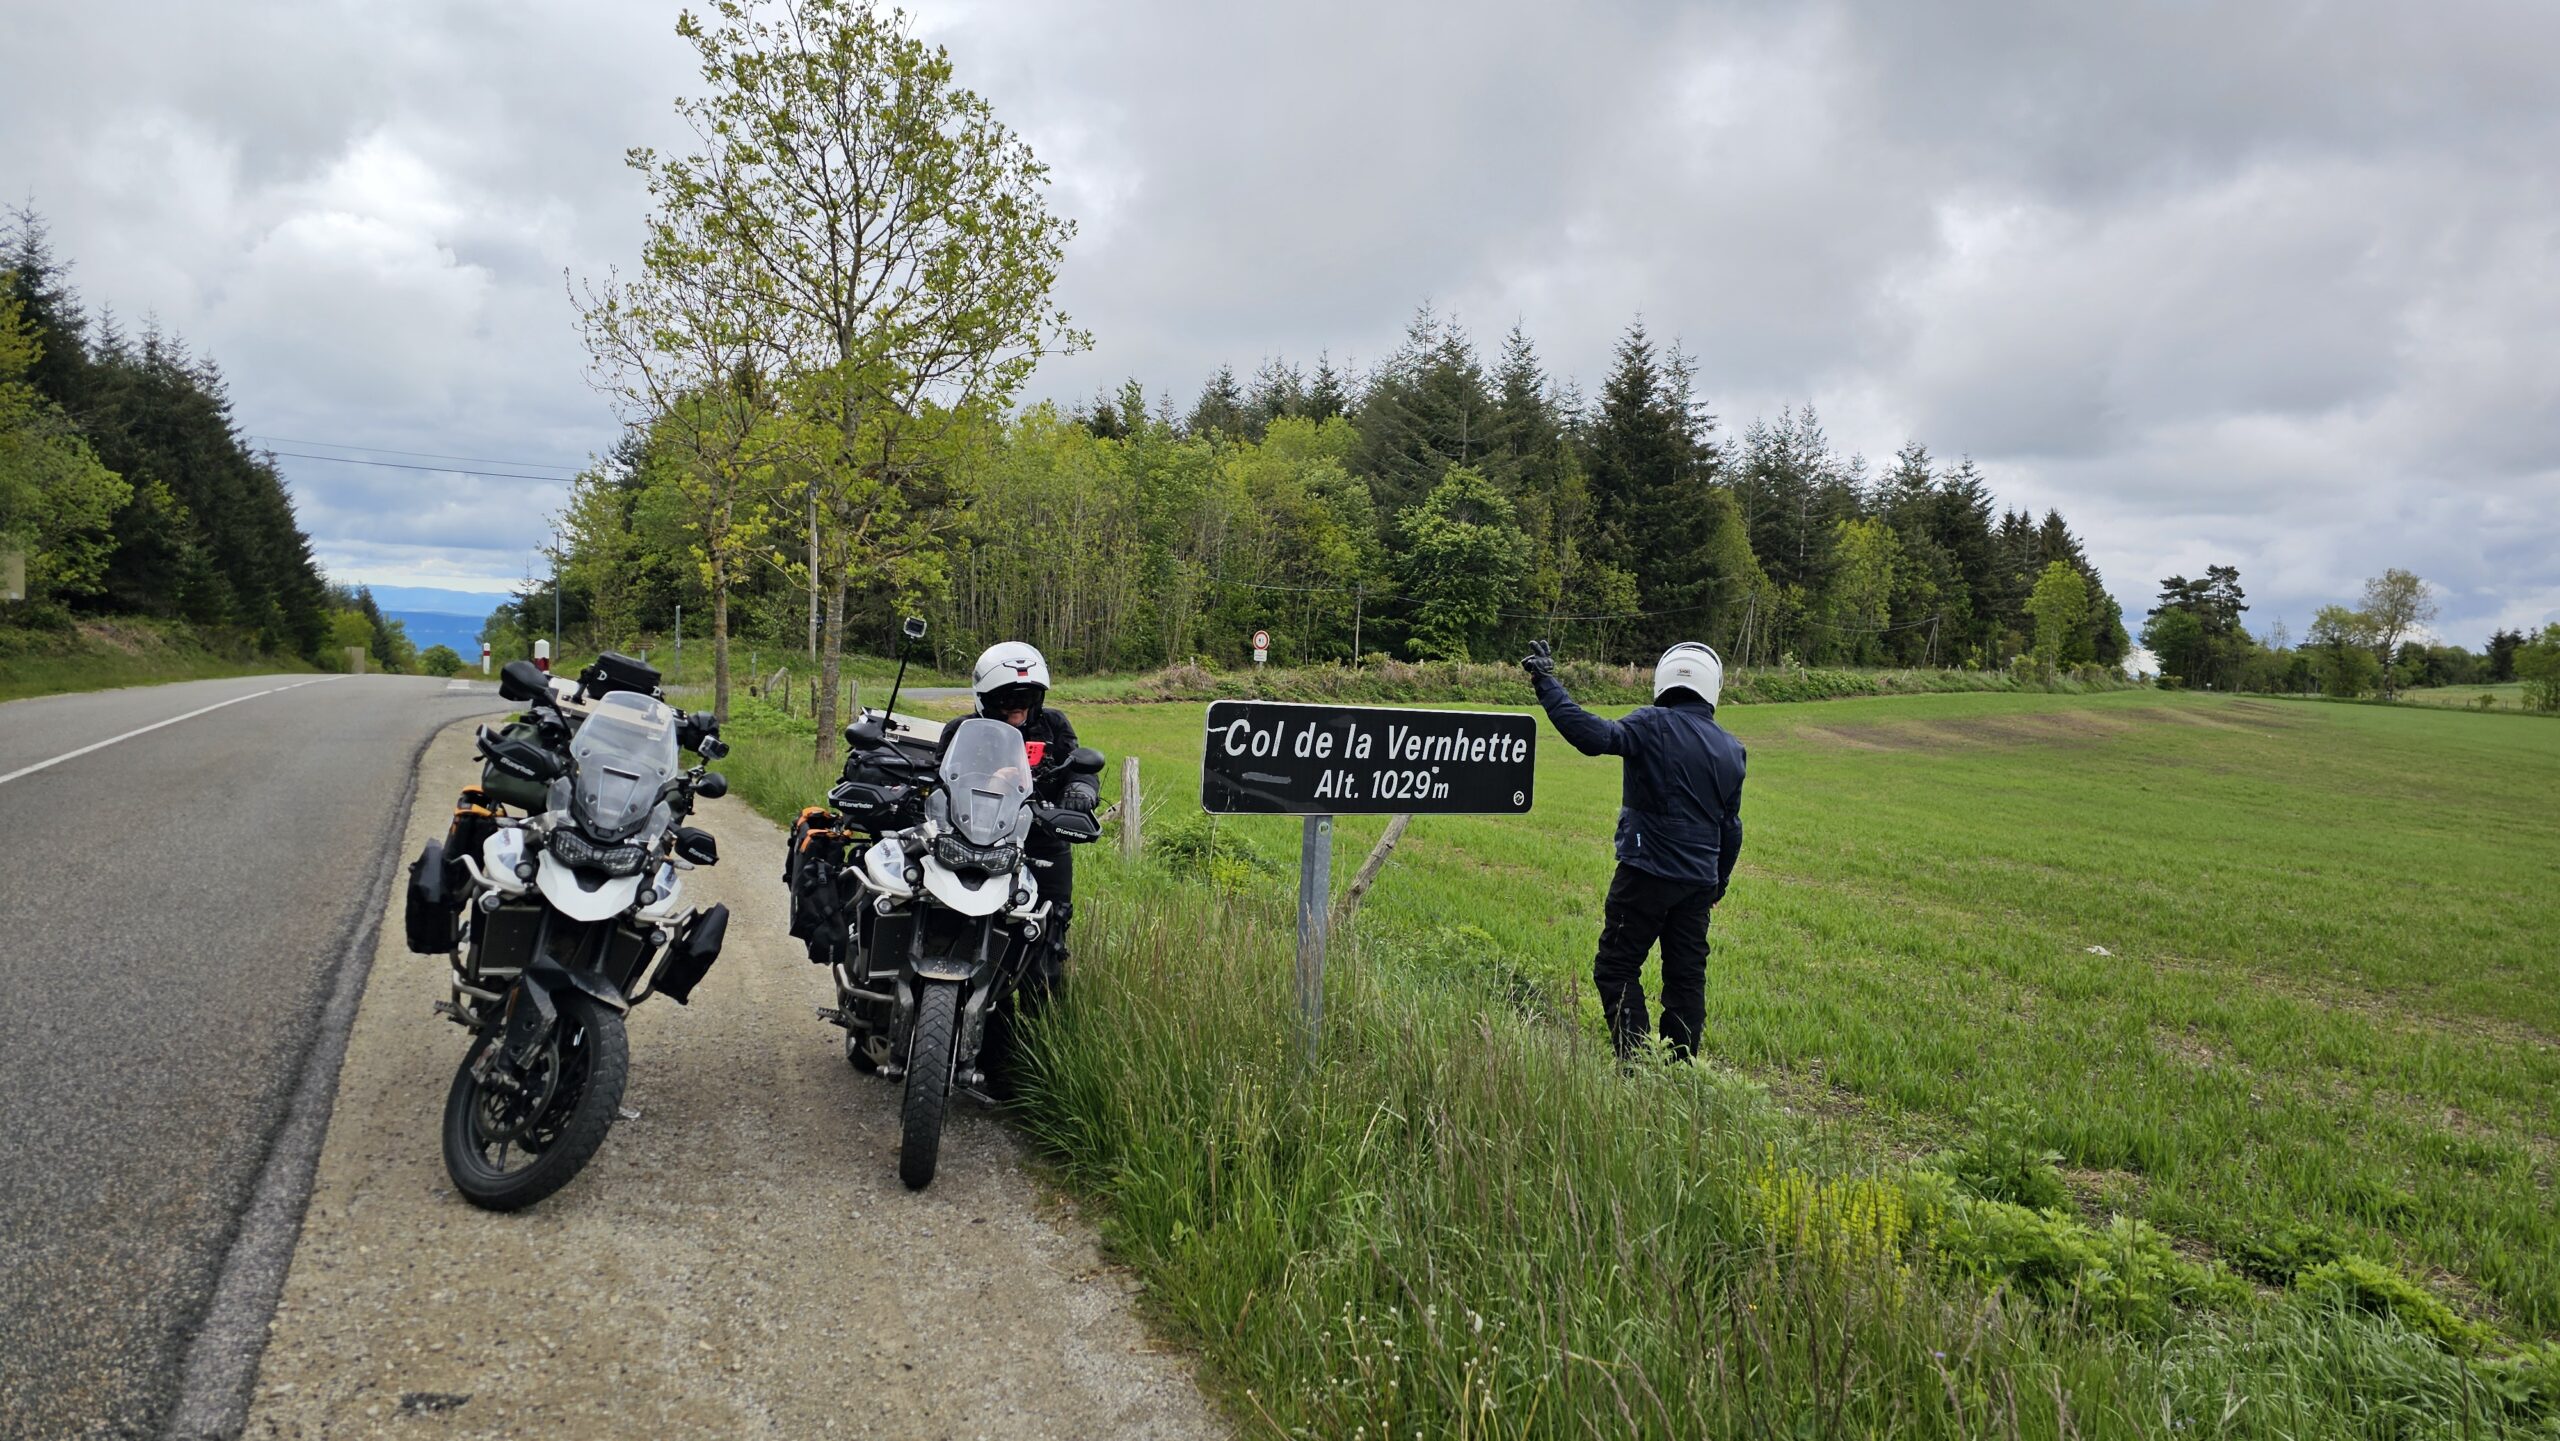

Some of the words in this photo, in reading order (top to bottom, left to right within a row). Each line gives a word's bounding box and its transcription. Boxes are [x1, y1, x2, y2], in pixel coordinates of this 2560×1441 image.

[1224, 719, 1284, 757] Col
[1295, 722, 1332, 758] de
[1345, 724, 1371, 759] la
[1388, 725, 1527, 763] Vernhette
[1313, 769, 1359, 799] Alt.
